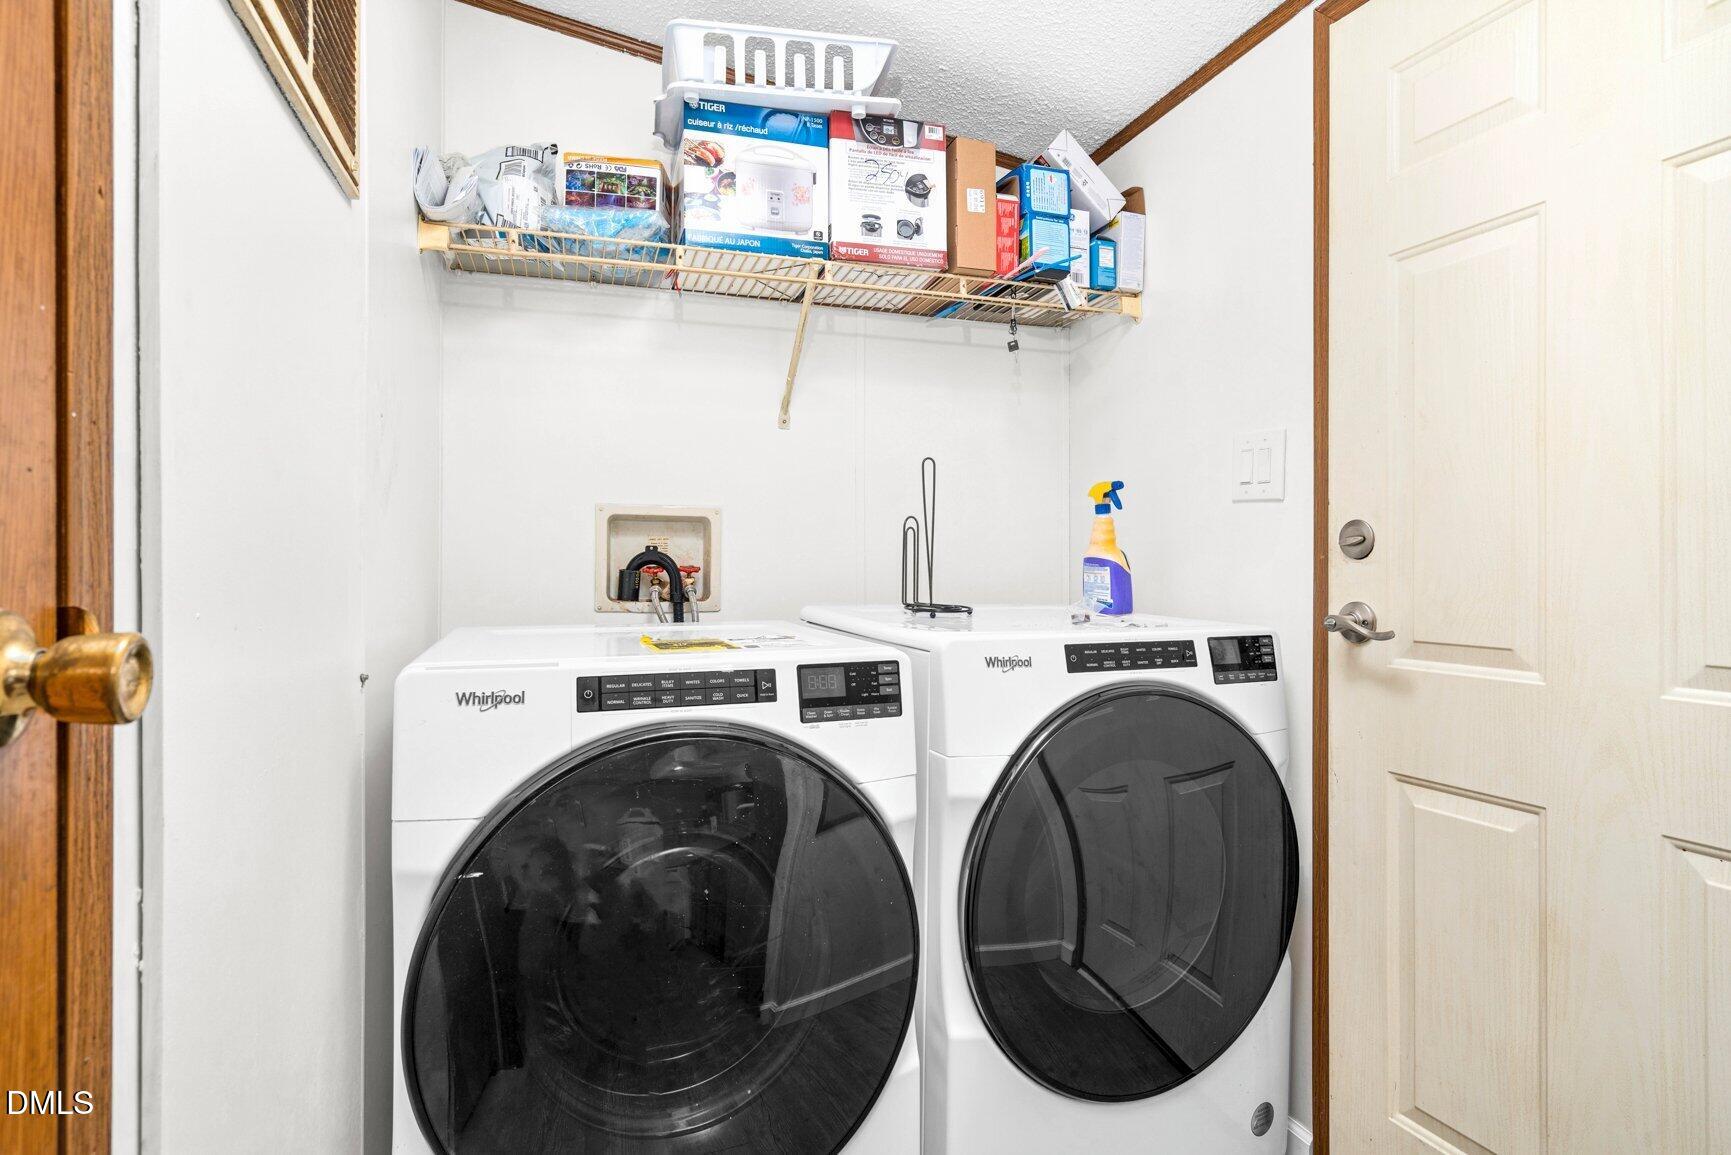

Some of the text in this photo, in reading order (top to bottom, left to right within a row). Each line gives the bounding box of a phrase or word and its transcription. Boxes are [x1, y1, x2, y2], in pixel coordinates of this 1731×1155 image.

[699, 101, 726, 113] TIGER
[687, 118, 715, 128] cuiseur
[717, 119, 722, 130] à
[723, 122, 733, 131] riz
[737, 239, 761, 247] JAPON
[846, 247, 869, 257] TIGER
[984, 655, 1032, 671] Whirlpool
[456, 690, 526, 709] Whirlpool
